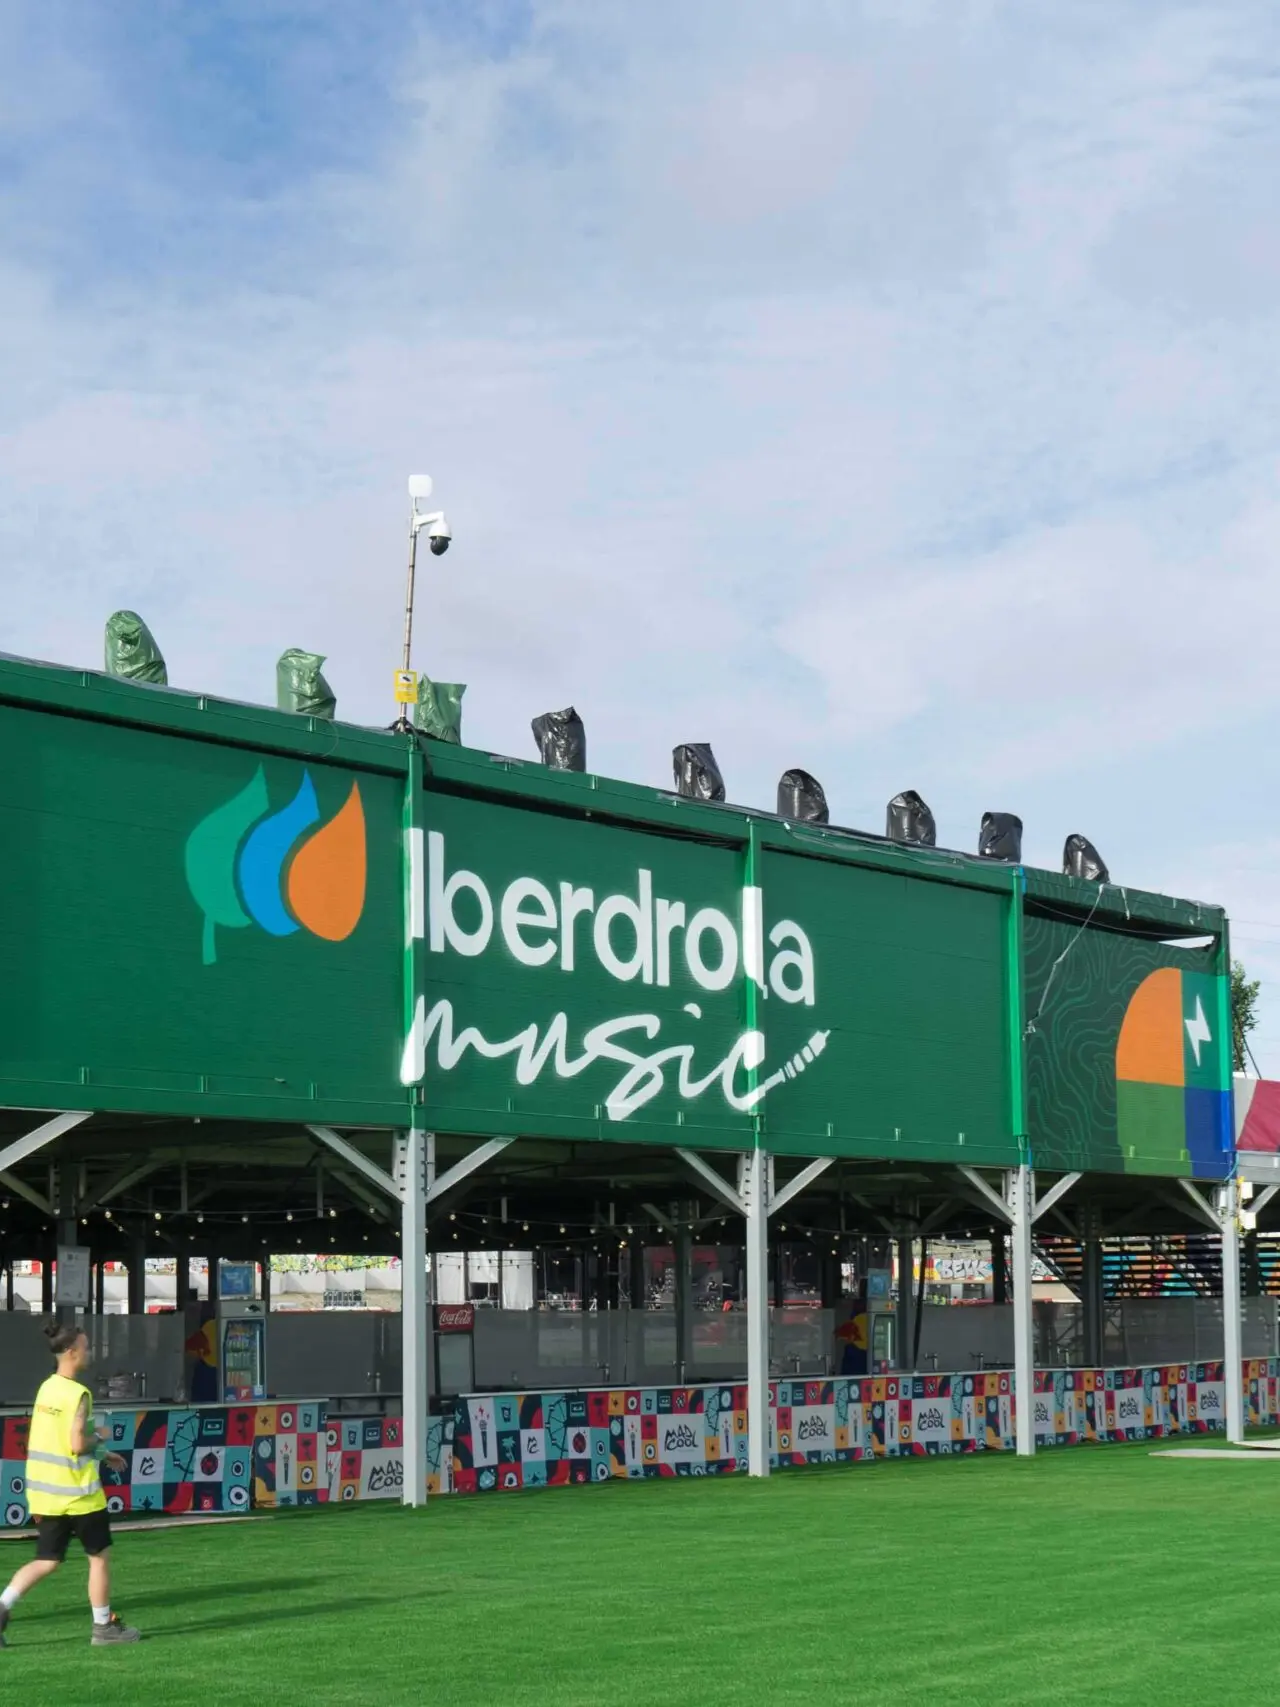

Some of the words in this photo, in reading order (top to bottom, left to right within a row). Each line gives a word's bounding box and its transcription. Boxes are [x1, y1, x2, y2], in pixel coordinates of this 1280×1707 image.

[403, 827, 815, 1006] Iberdrola
[400, 994, 830, 1121] music
[800, 1420, 829, 1440] COOL
[919, 1412, 945, 1431] COOL
[667, 1430, 699, 1451] COOL
[371, 1476, 404, 1491] COO
